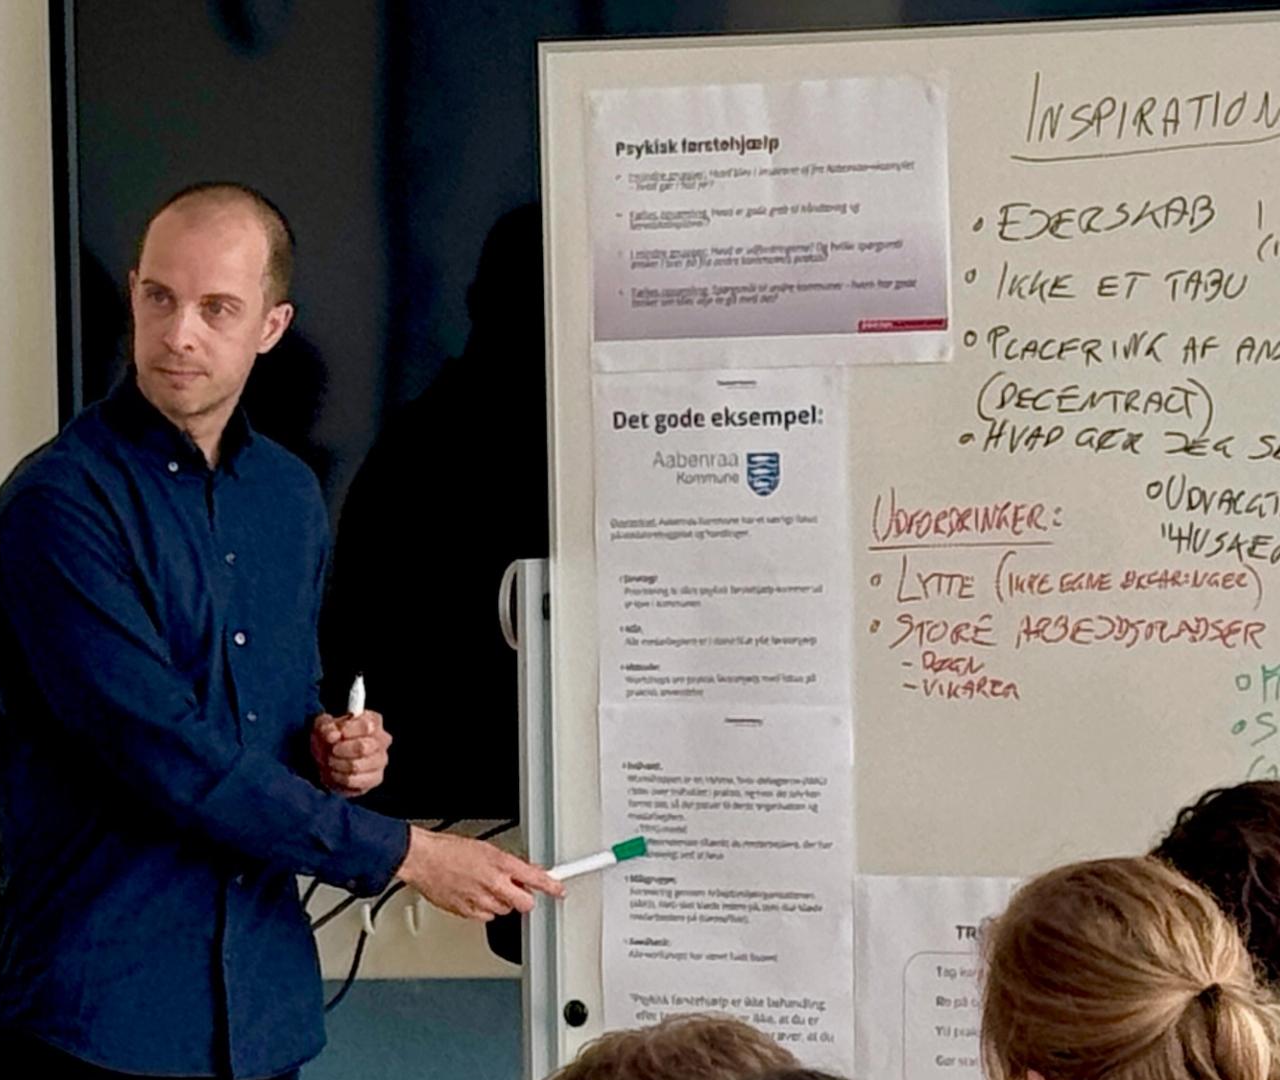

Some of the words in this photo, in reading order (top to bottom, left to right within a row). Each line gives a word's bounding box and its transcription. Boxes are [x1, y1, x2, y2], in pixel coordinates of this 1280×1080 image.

[615, 138, 678, 160] Psykisk
[997, 261, 1076, 303] IKKE
[1096, 271, 1151, 300] ET
[1164, 268, 1249, 302] TABU
[1182, 336, 1221, 365] AF
[612, 411, 650, 430] Det
[654, 408, 706, 435] gode
[711, 404, 824, 432] eksempel:
[982, 418, 1064, 455] HVAD
[652, 450, 740, 469] Aabenraa
[676, 472, 740, 485] Kommune
[897, 554, 976, 603] LYTTE
[888, 613, 998, 649] STORE
